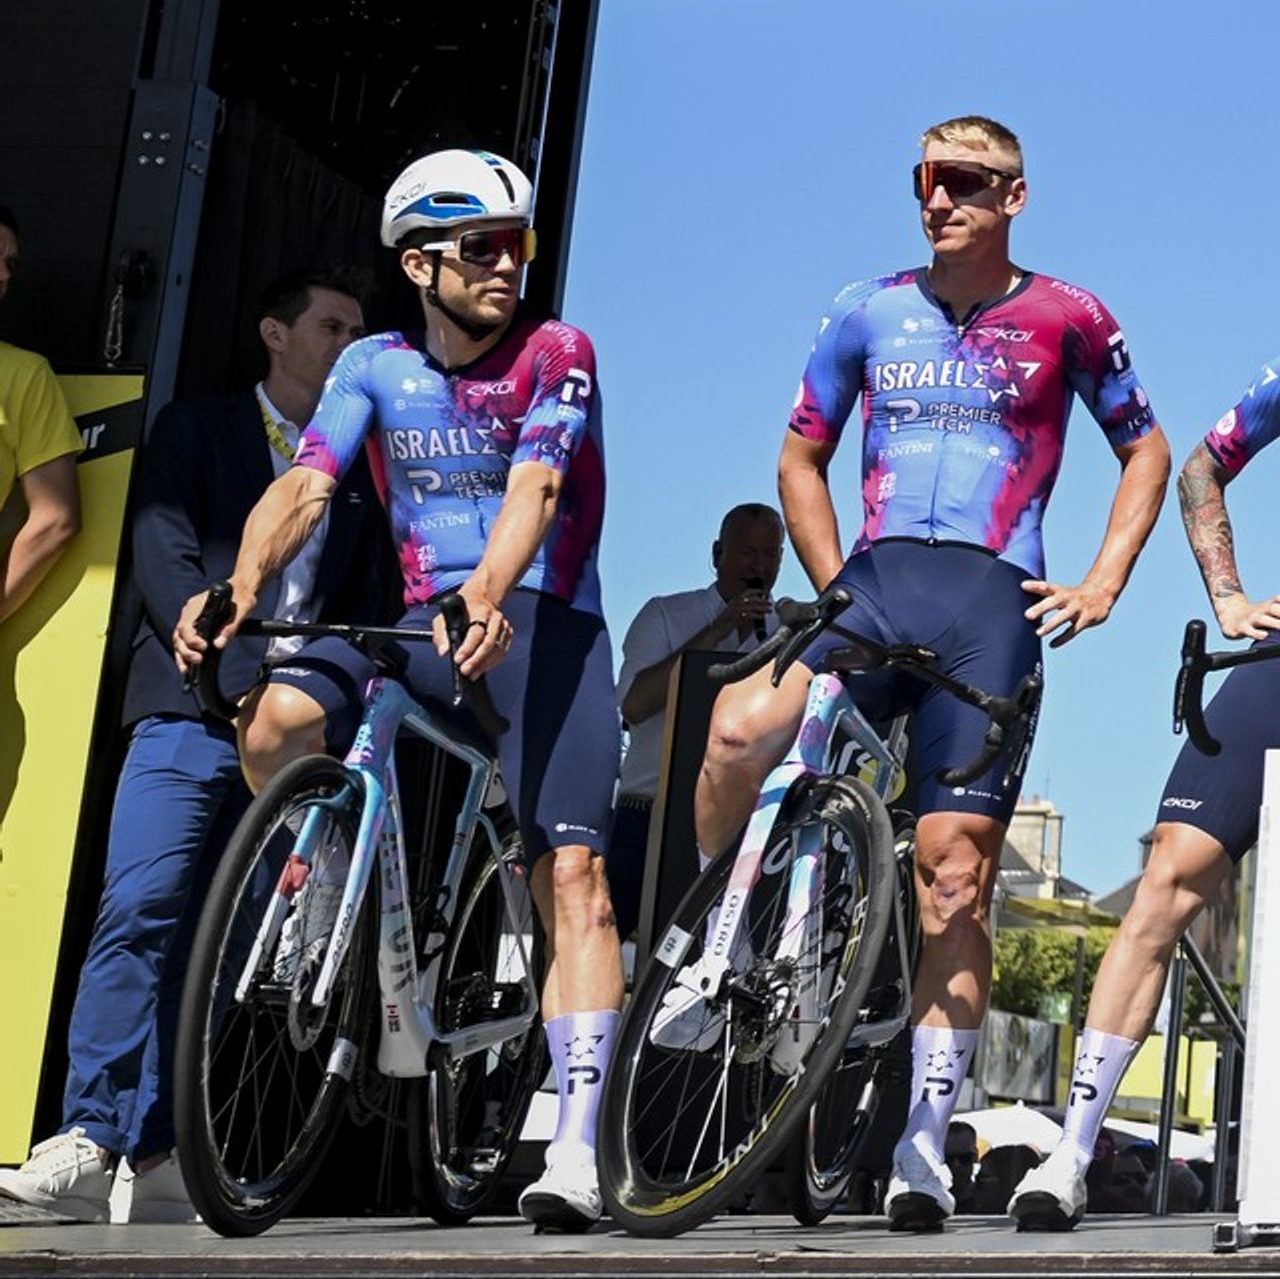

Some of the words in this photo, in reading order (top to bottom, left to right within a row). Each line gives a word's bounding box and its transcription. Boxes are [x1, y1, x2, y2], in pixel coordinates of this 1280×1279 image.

[876, 361, 967, 392] ISRAEL
[928, 403, 1002, 425] PREMIER
[930, 417, 972, 434] TECH
[387, 427, 478, 461] ISRAEL
[714, 894, 739, 956] OSTRO
